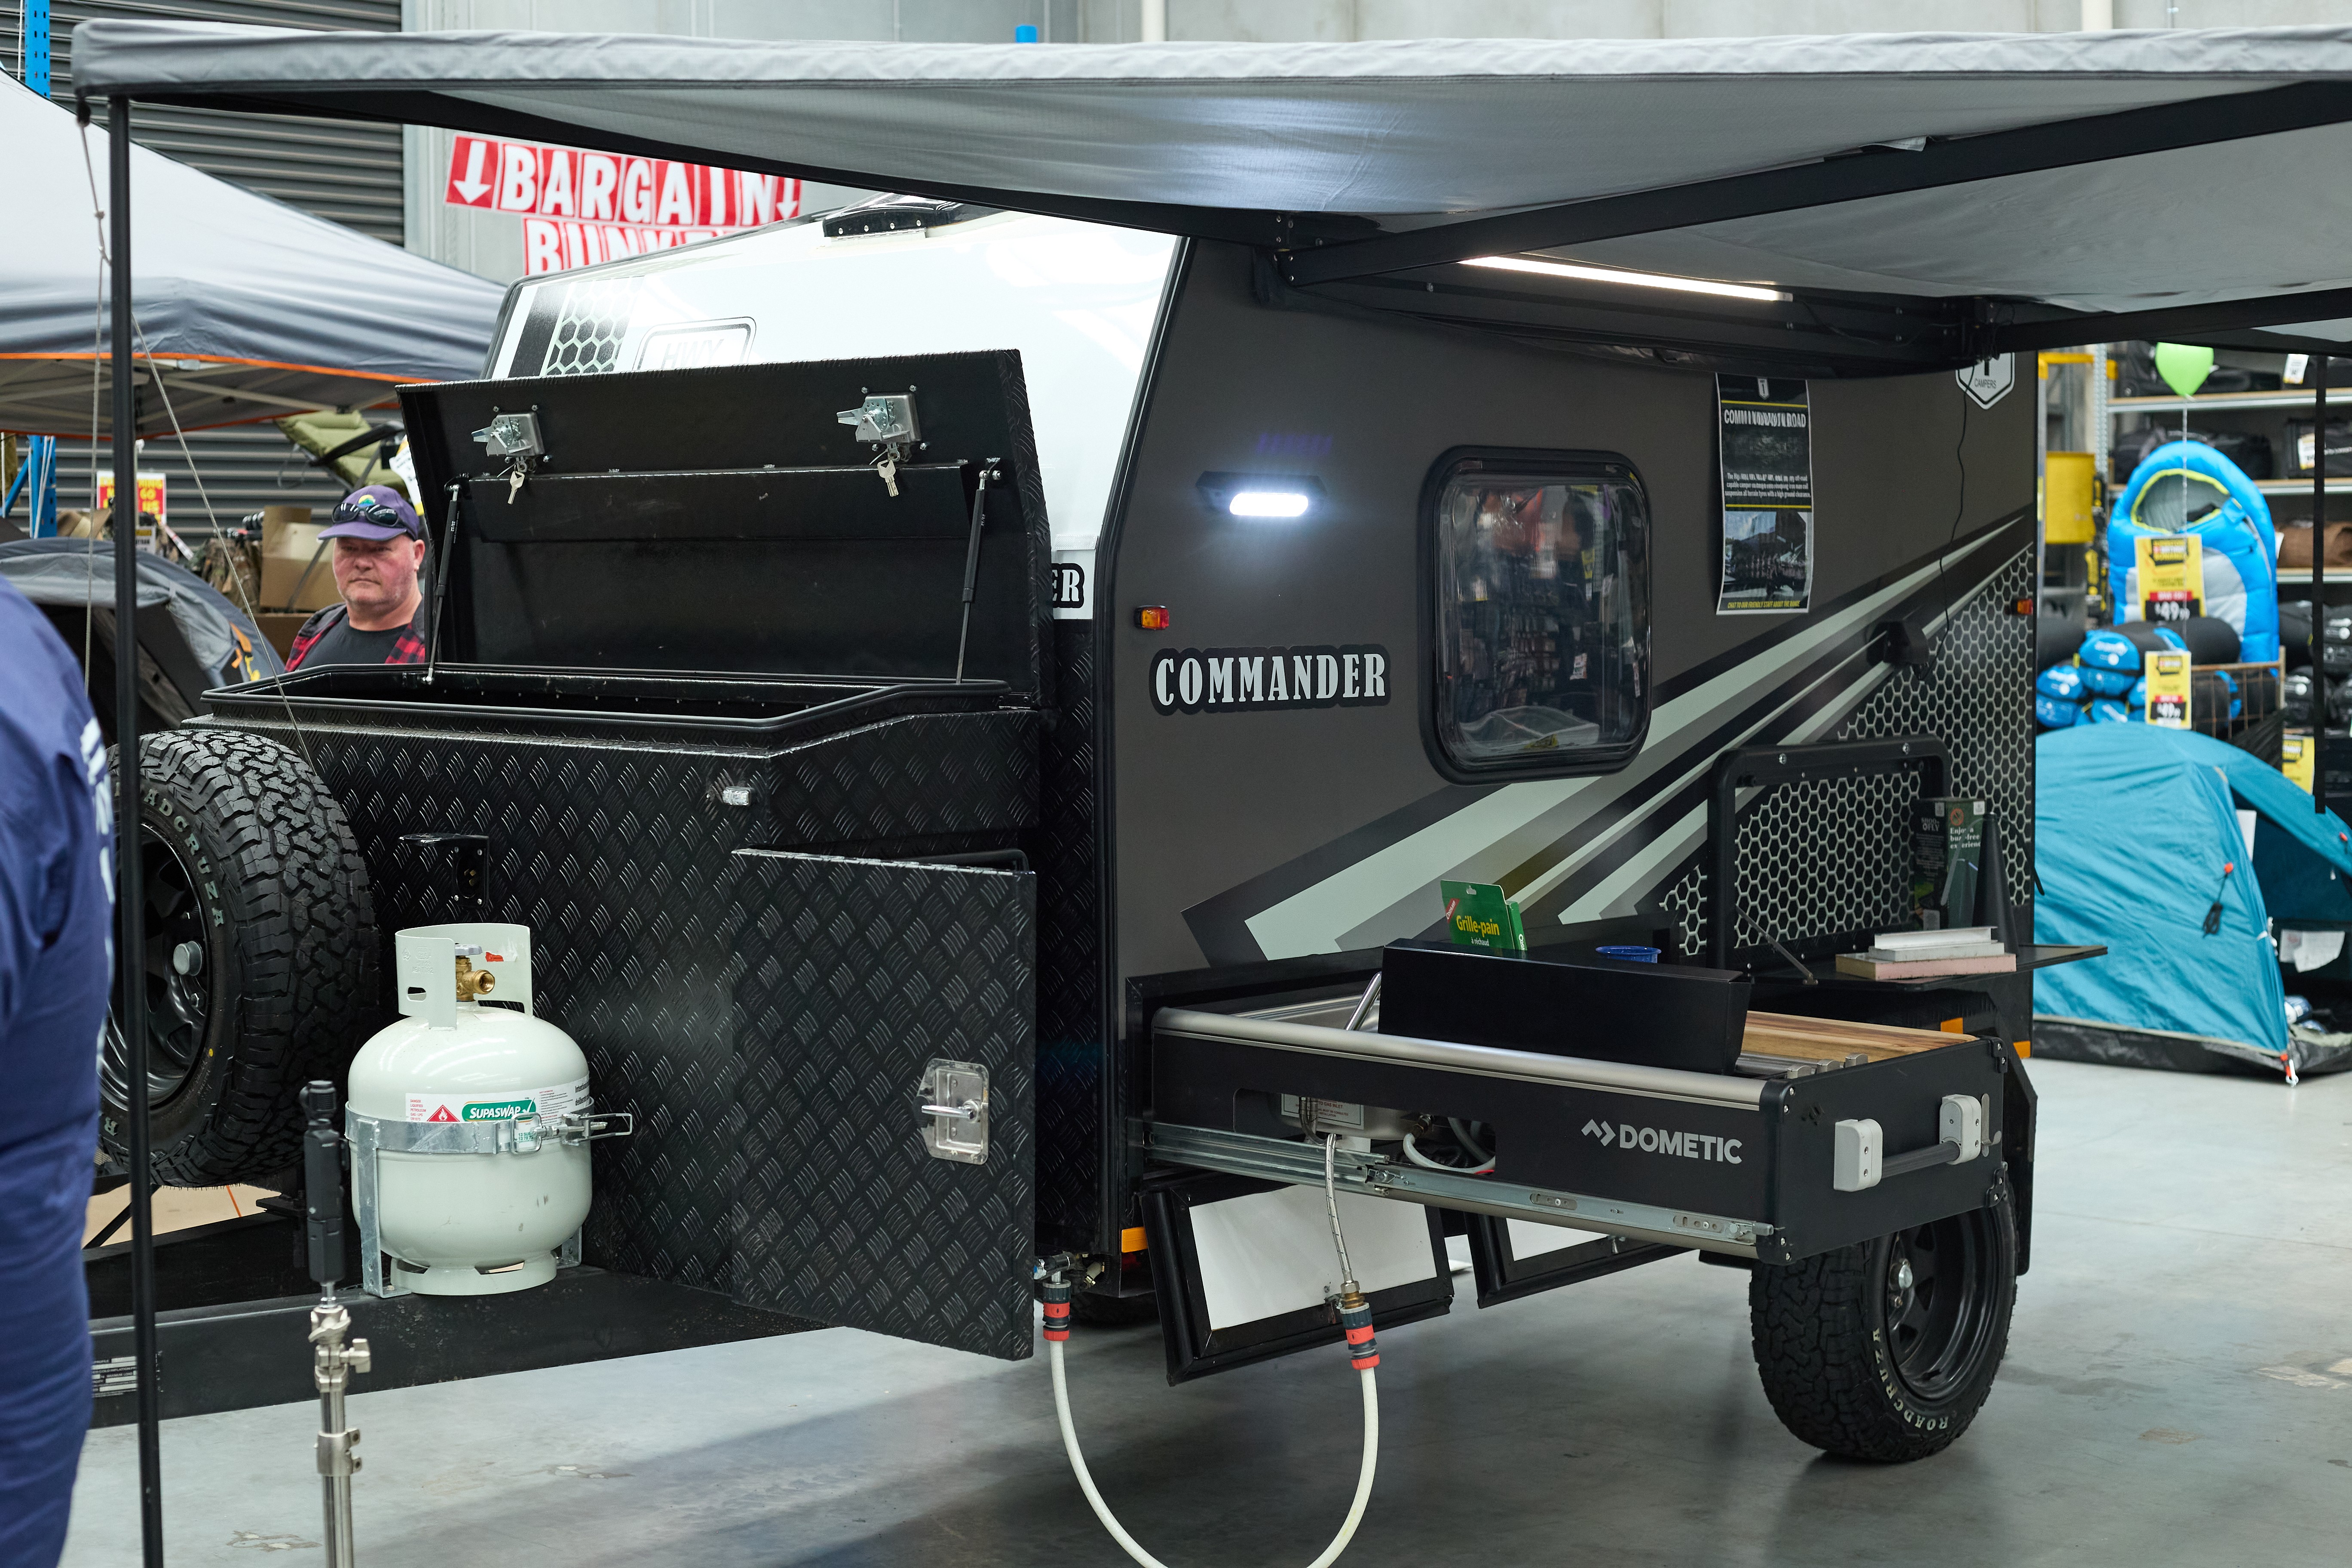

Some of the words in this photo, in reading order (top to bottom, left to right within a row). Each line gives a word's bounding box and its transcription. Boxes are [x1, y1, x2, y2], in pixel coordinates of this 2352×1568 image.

[500, 145, 772, 226] BARGAIN
[661, 339, 724, 369] HWY
[1975, 379, 1997, 389] CAMPERS
[1156, 653, 1385, 706] COMMANDER
[1456, 915, 1500, 937] Grille-pain
[1474, 937, 1489, 946] réchaud
[469, 1104, 521, 1119] SUPASWAP
[1620, 1124, 1743, 1164] DOMETIC
[1873, 1328, 1948, 1430] ROADCRUZA
